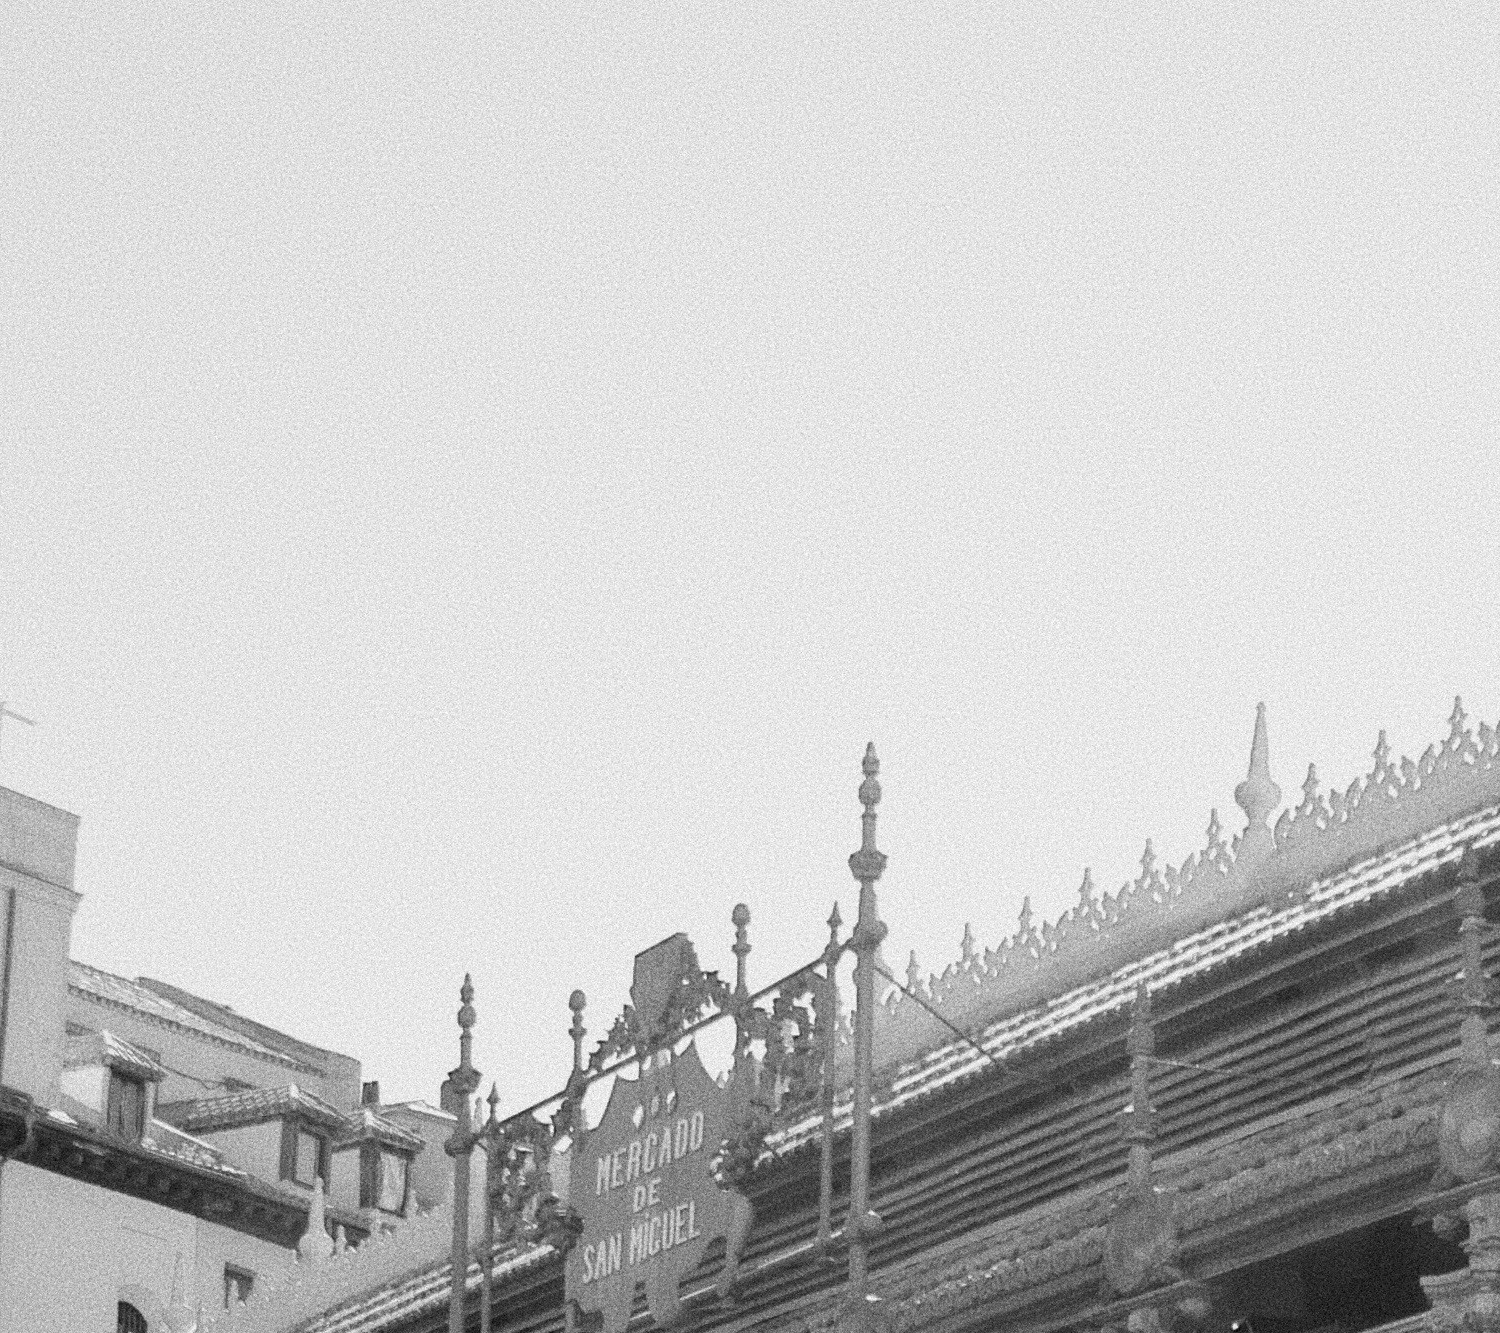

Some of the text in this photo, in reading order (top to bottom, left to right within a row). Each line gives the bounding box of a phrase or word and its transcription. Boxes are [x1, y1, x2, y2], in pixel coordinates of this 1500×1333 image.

[595, 1110, 704, 1196] MERCADO
[633, 1176, 661, 1213] DE
[582, 1232, 622, 1284] SAN
